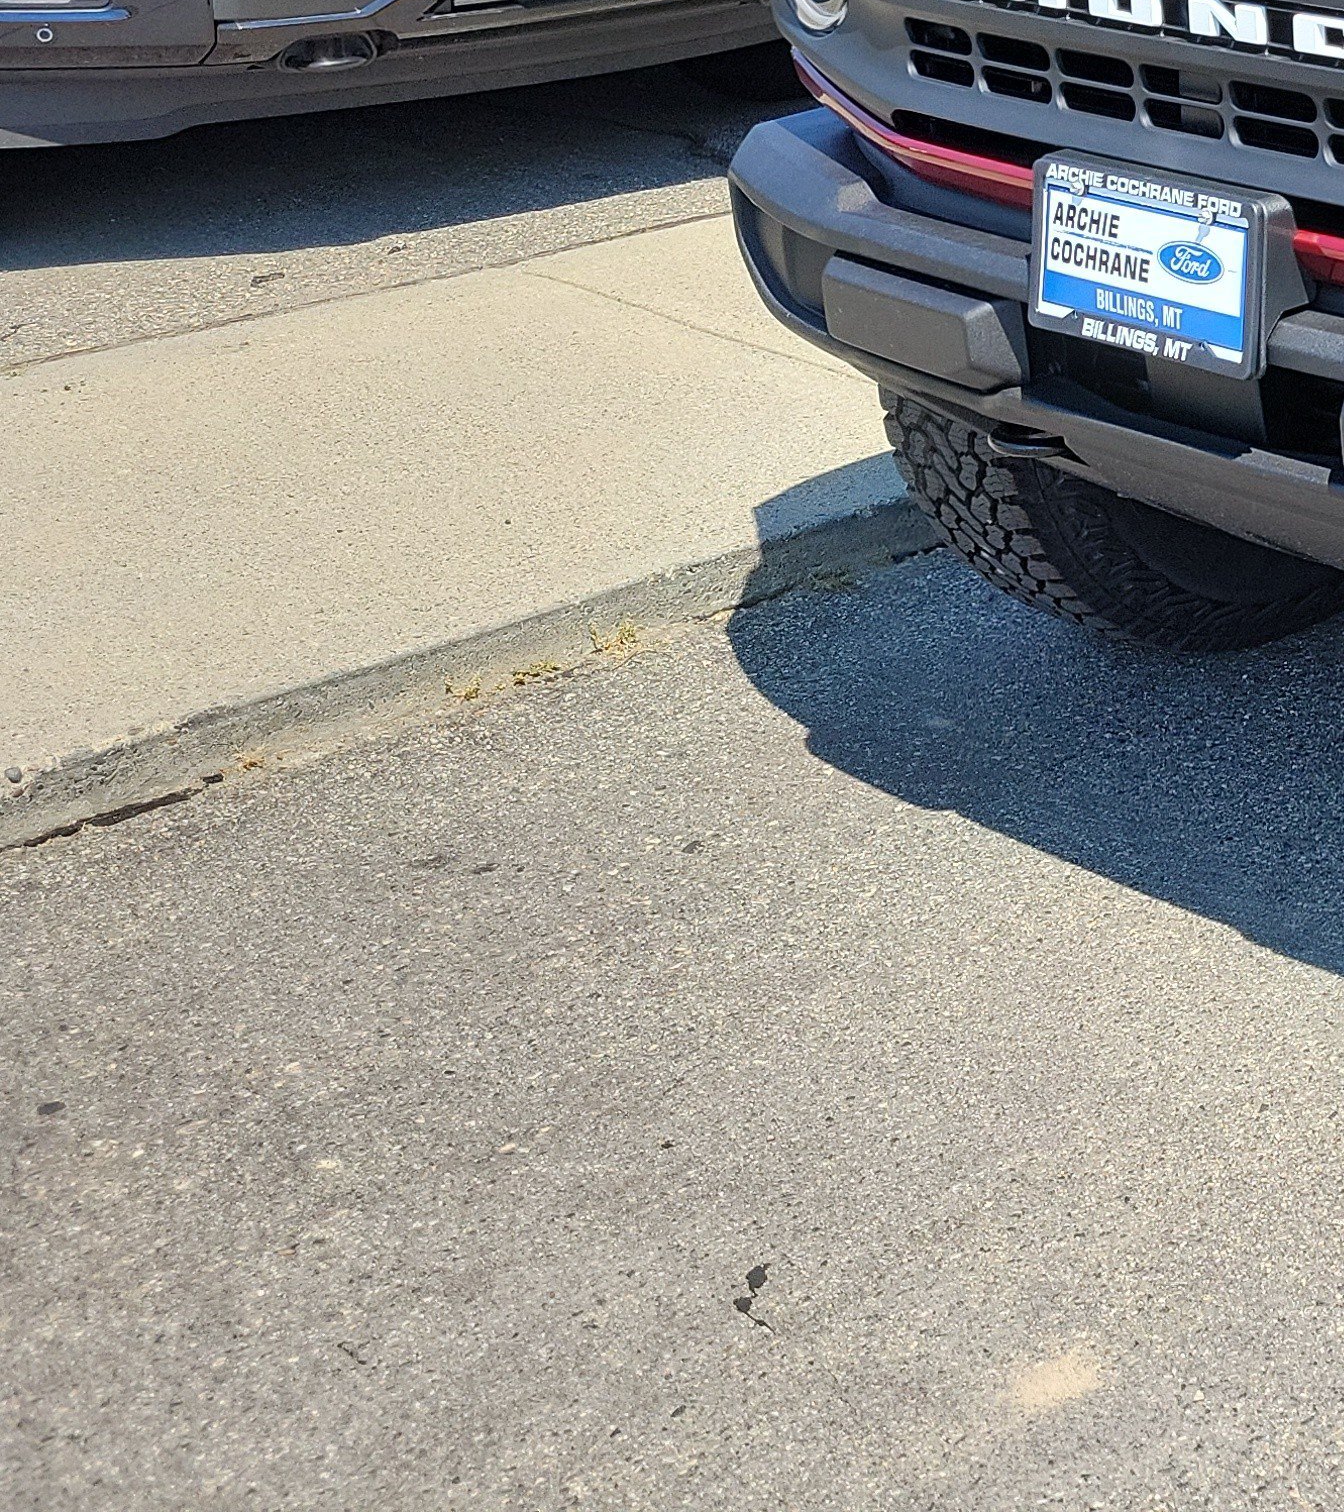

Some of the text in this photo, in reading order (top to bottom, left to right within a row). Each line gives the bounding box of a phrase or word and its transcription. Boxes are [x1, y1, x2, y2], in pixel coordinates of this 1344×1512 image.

[1046, 163, 1242, 218] ARCHIE COCHRANE FORD
[1052, 202, 1121, 238] ARCHIE
[1050, 236, 1150, 283] COCHRANE
[1170, 245, 1211, 278] Ford
[1096, 288, 1183, 330] BILLINGS, MT
[1081, 317, 1194, 361] BILLINGS, MT
